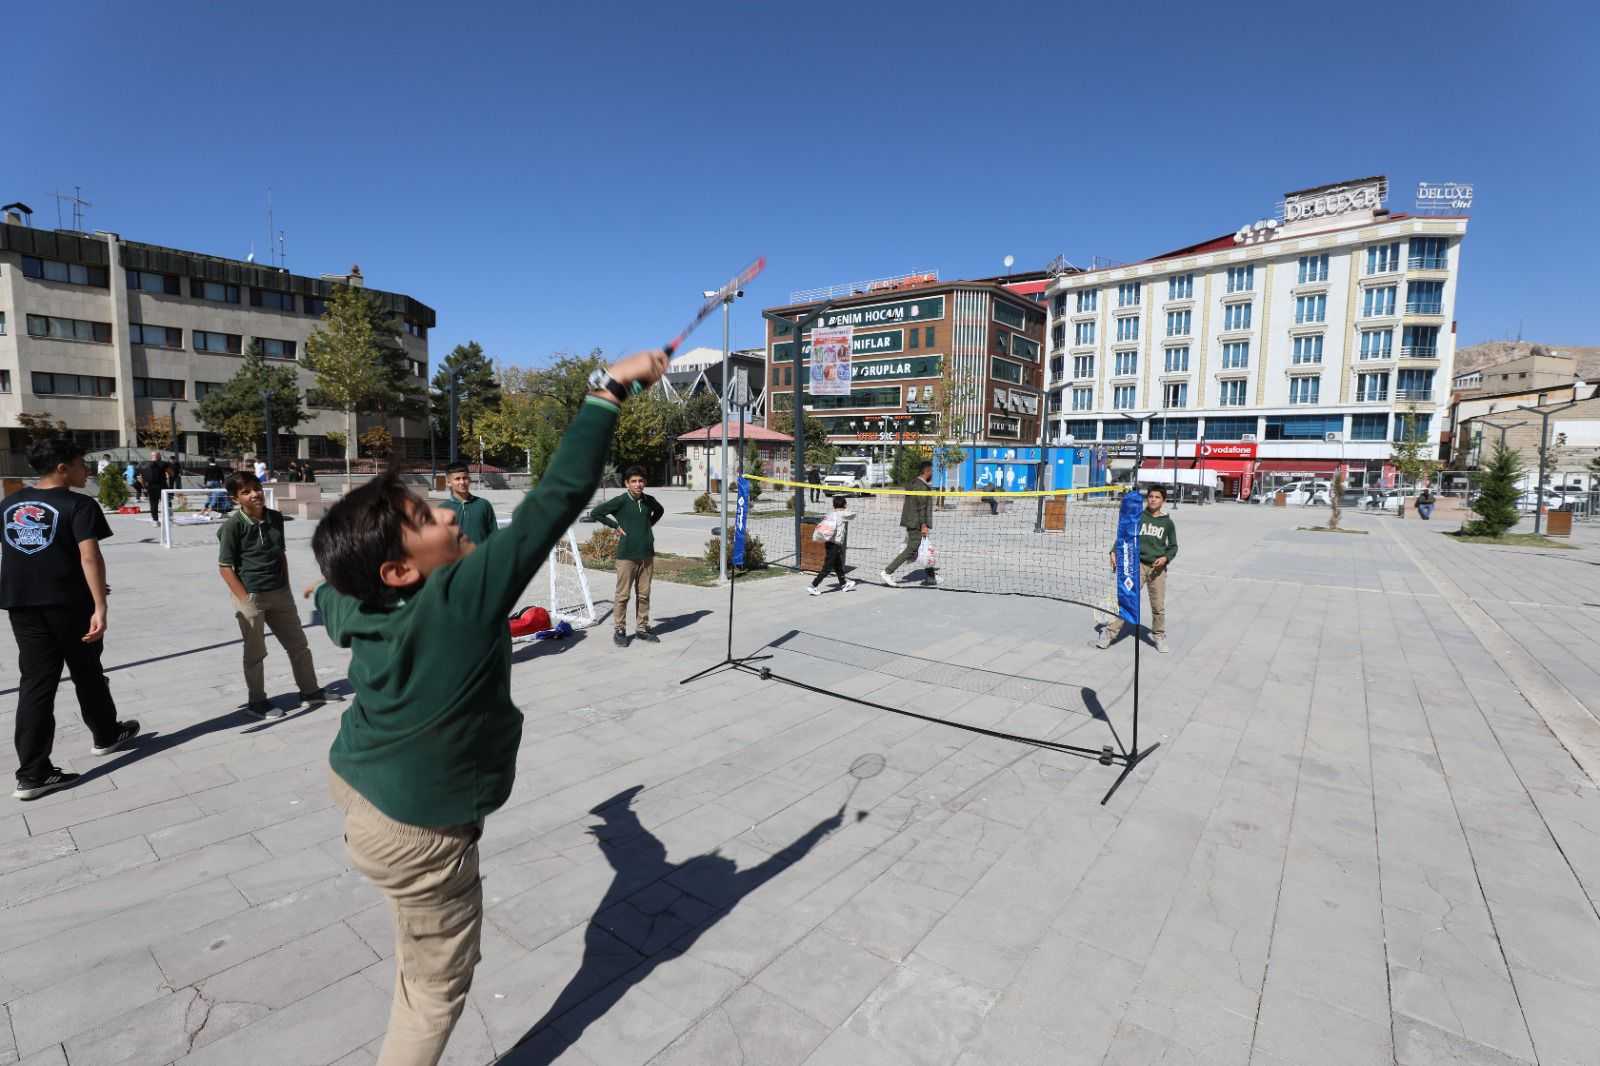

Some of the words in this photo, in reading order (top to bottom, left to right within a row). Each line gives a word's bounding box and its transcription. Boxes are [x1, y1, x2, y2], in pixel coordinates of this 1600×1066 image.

[1417, 187, 1473, 199] DELUXE
[1285, 187, 1376, 220] DELUXE
[865, 307, 904, 322] HOCAM
[853, 337, 891, 350] NIFLAR
[861, 363, 911, 377] GRUPLAR
[1213, 446, 1251, 454] vodafone
